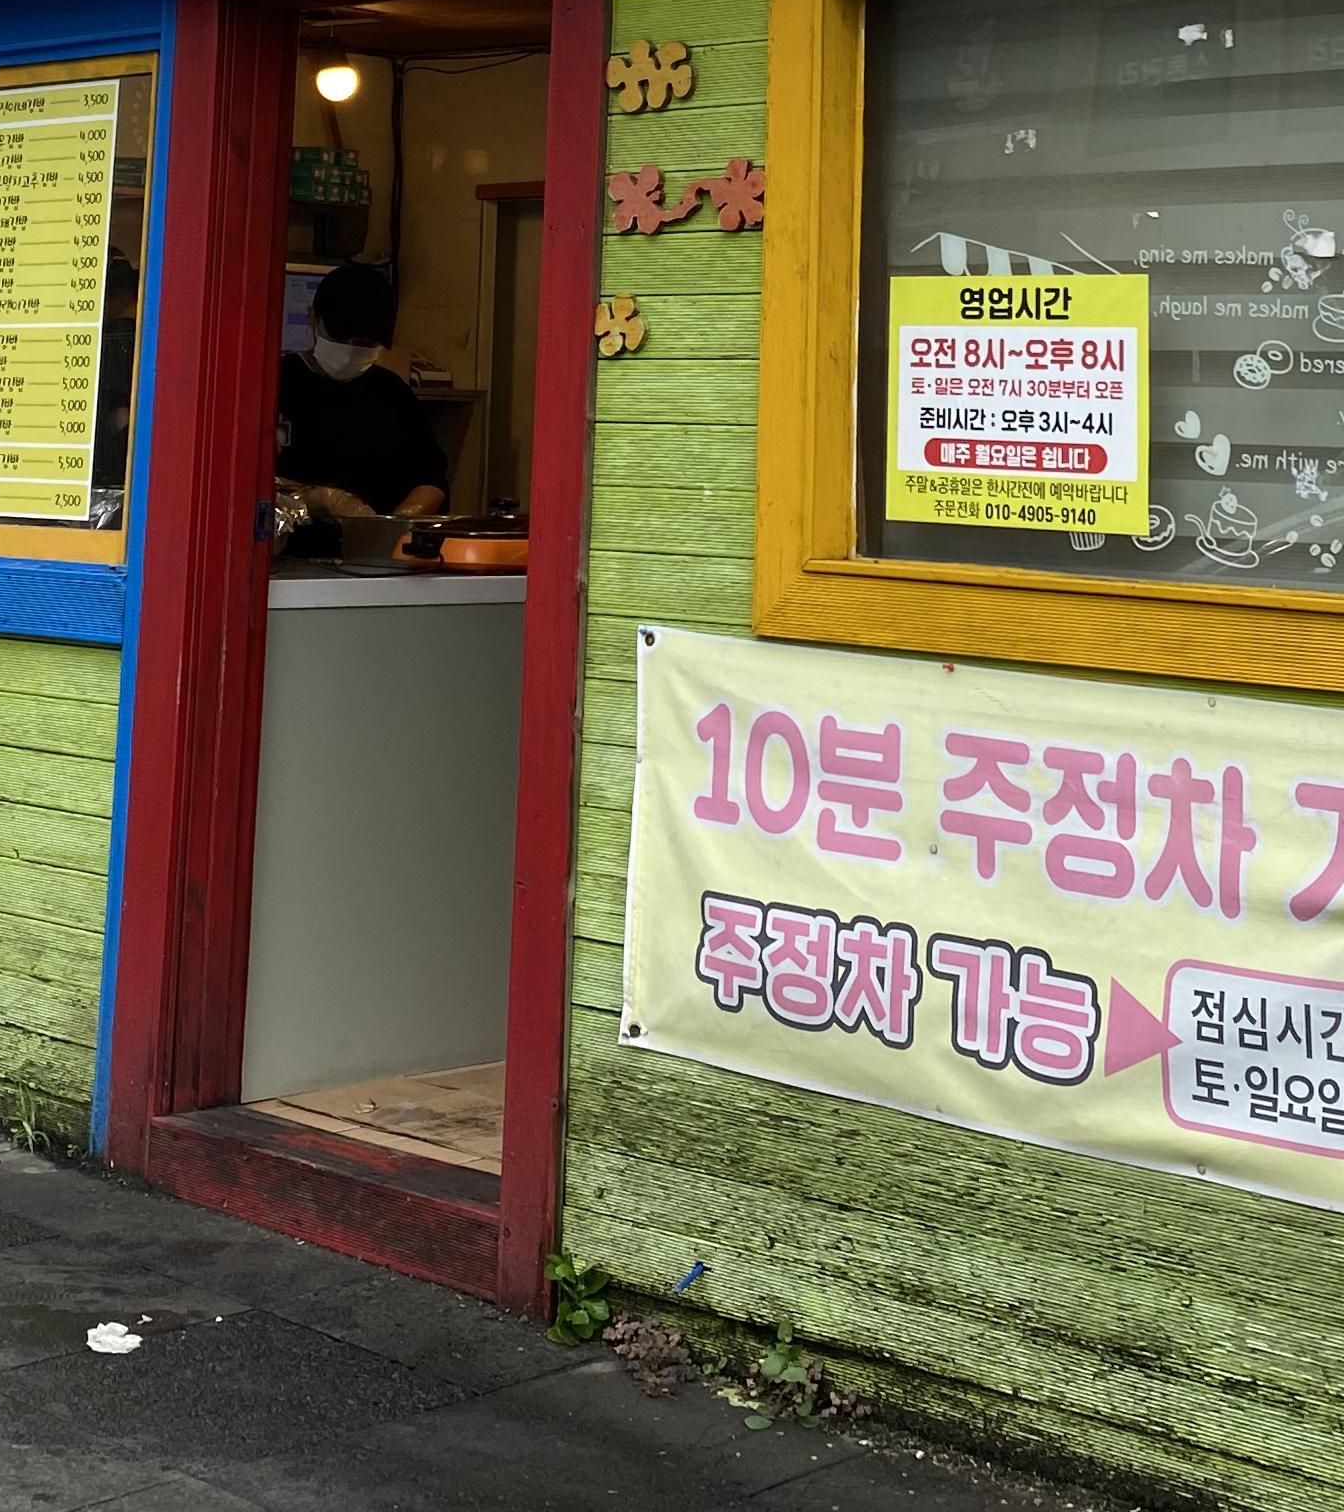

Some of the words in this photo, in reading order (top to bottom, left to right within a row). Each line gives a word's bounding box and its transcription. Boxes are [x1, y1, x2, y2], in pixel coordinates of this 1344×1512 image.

[83, 93, 109, 109] 3,500
[79, 129, 107, 144] 4,000
[79, 150, 105, 166] 4,500
[78, 171, 104, 186] 4,500
[76, 192, 102, 208] 4,500
[75, 214, 101, 229] 4,500
[73, 235, 99, 250] 4,500
[72, 256, 98, 272] 4,500
[70, 278, 96, 294] 4,500
[69, 299, 95, 315] 4,500
[960, 287, 1072, 320] 영업시간
[65, 334, 92, 349] 5,000
[64, 355, 91, 370] 5,000
[910, 337, 957, 369] 오전
[1080, 339, 1125, 372] 8시
[62, 377, 89, 392] 5,000
[968, 378, 995, 396] 오전
[998, 379, 1022, 398] 7시
[1027, 380, 1091, 400] 30분부터
[1095, 380, 1124, 400] 오픈
[61, 398, 87, 414] 5,000
[59, 421, 86, 436] 5,000
[919, 407, 986, 431] 준비시간
[1001, 410, 1036, 433] 오후
[1038, 411, 1113, 436] 3시~4시
[58, 456, 84, 472] 5,500
[940, 443, 972, 465] 매주
[974, 444, 1037, 467] 월요일은
[1041, 446, 1091, 470] 쉽니다
[905, 475, 983, 498] 주말&공휴일은
[986, 478, 1046, 500] 한시간전에
[1049, 481, 1129, 504] 예약바랍니다
[54, 494, 82, 509] 2,500
[933, 500, 980, 519] 주문전화
[985, 503, 1096, 525] 010-4905-9140
[693, 701, 904, 863] 10분
[940, 731, 1257, 920] 주정차
[699, 892, 920, 1047] 주정차
[930, 934, 1100, 1085] 가능
